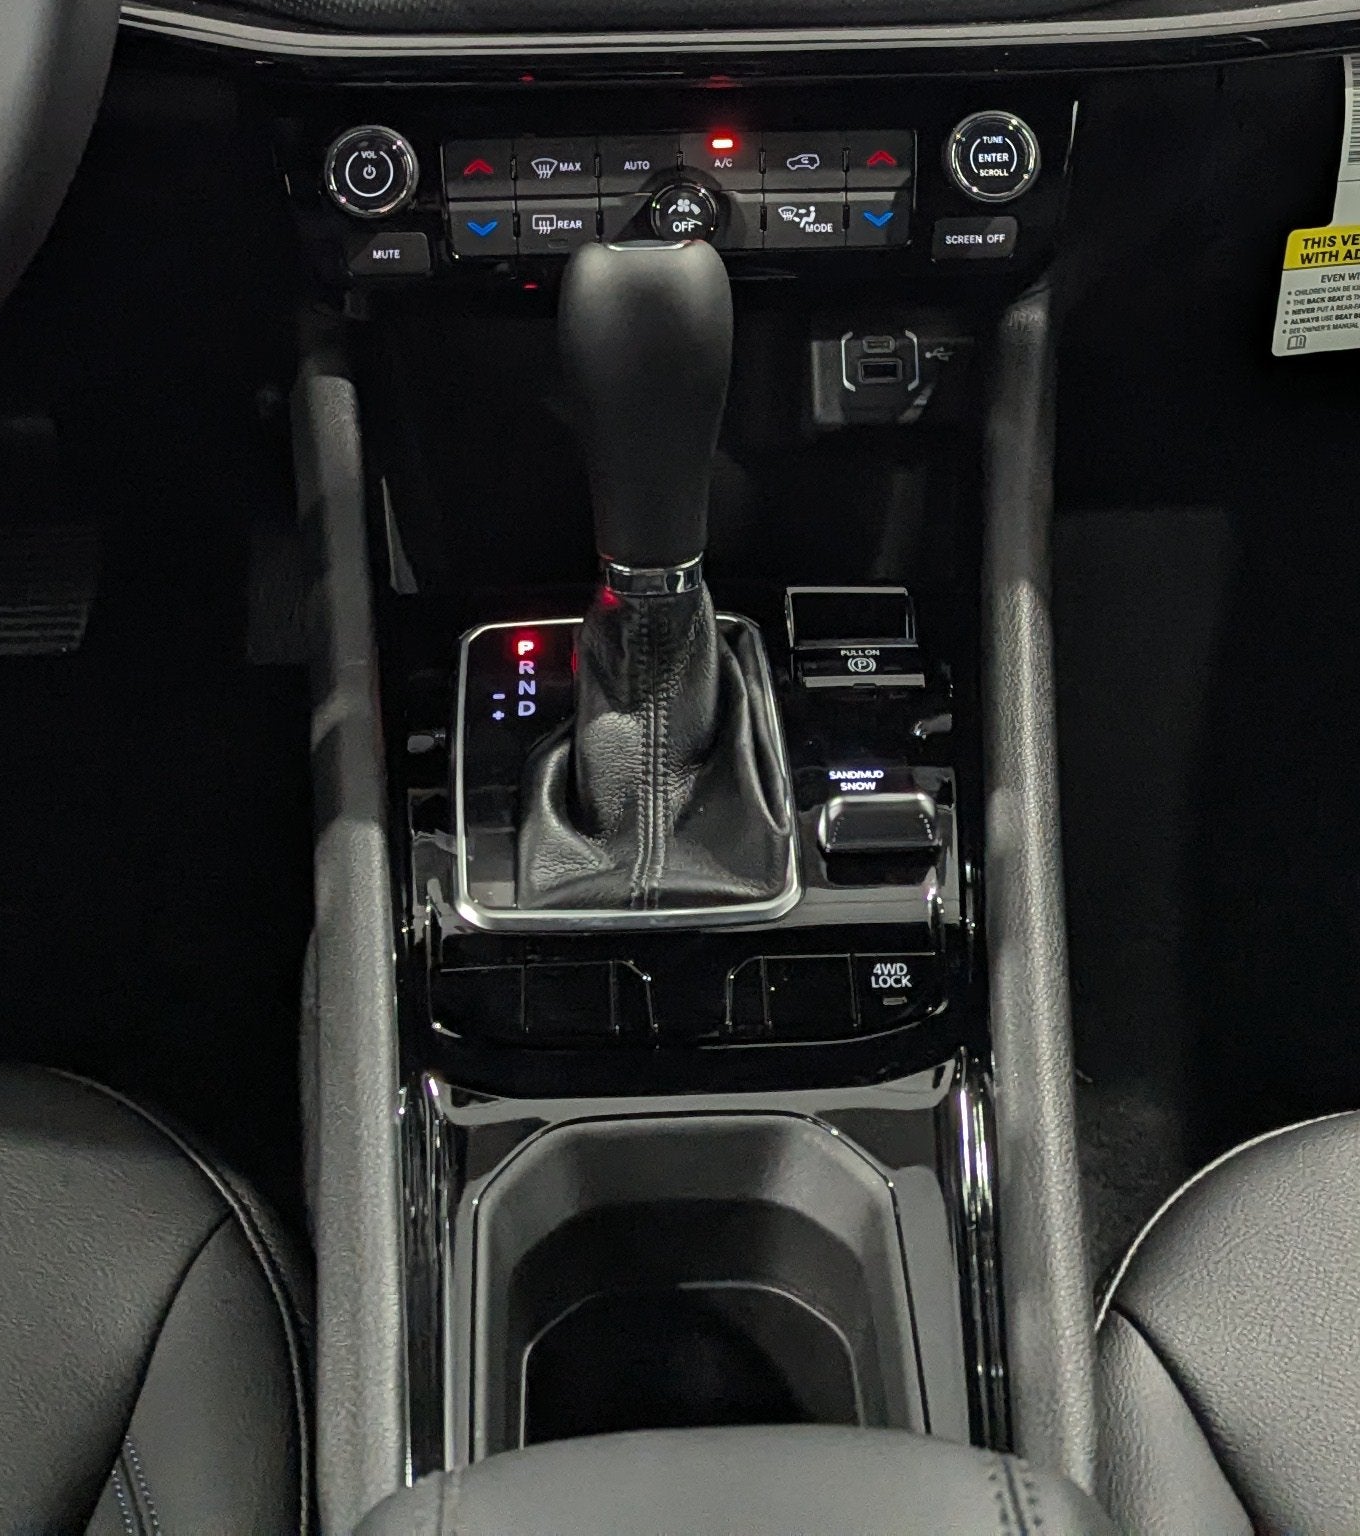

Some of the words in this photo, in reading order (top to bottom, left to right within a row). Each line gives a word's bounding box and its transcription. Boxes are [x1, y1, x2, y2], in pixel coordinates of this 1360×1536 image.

[982, 136, 1004, 144] TUNE
[360, 150, 378, 158] VOL
[978, 152, 1010, 163] ENTER
[560, 162, 582, 172] MAX
[624, 160, 650, 170] AUTO
[714, 158, 733, 168] A/C
[979, 168, 1009, 177] SCROLL
[556, 220, 582, 230] REAR
[672, 221, 695, 232] OFF
[805, 223, 834, 233] MODE
[945, 234, 982, 244] SCREEN
[986, 234, 1006, 244] OFF
[1302, 235, 1337, 250] THIS
[372, 249, 400, 260] MUTE
[1300, 250, 1340, 264] WITH
[1320, 272, 1346, 284] EVEN
[1294, 286, 1326, 297] CHILDREN
[1328, 286, 1342, 294] CAN
[1306, 296, 1326, 304] BACK
[1292, 307, 1316, 316] NEVER
[1290, 316, 1320, 325] ALWAYS
[1320, 314, 1334, 322] USE
[1332, 322, 1360, 330] MANUAL
[518, 640, 534, 656] P
[518, 660, 535, 675] R
[518, 680, 536, 696] N
[518, 700, 536, 716] D
[840, 782, 876, 791] SNOW
[873, 962, 908, 976] 4WD
[870, 974, 912, 988] LOCK
